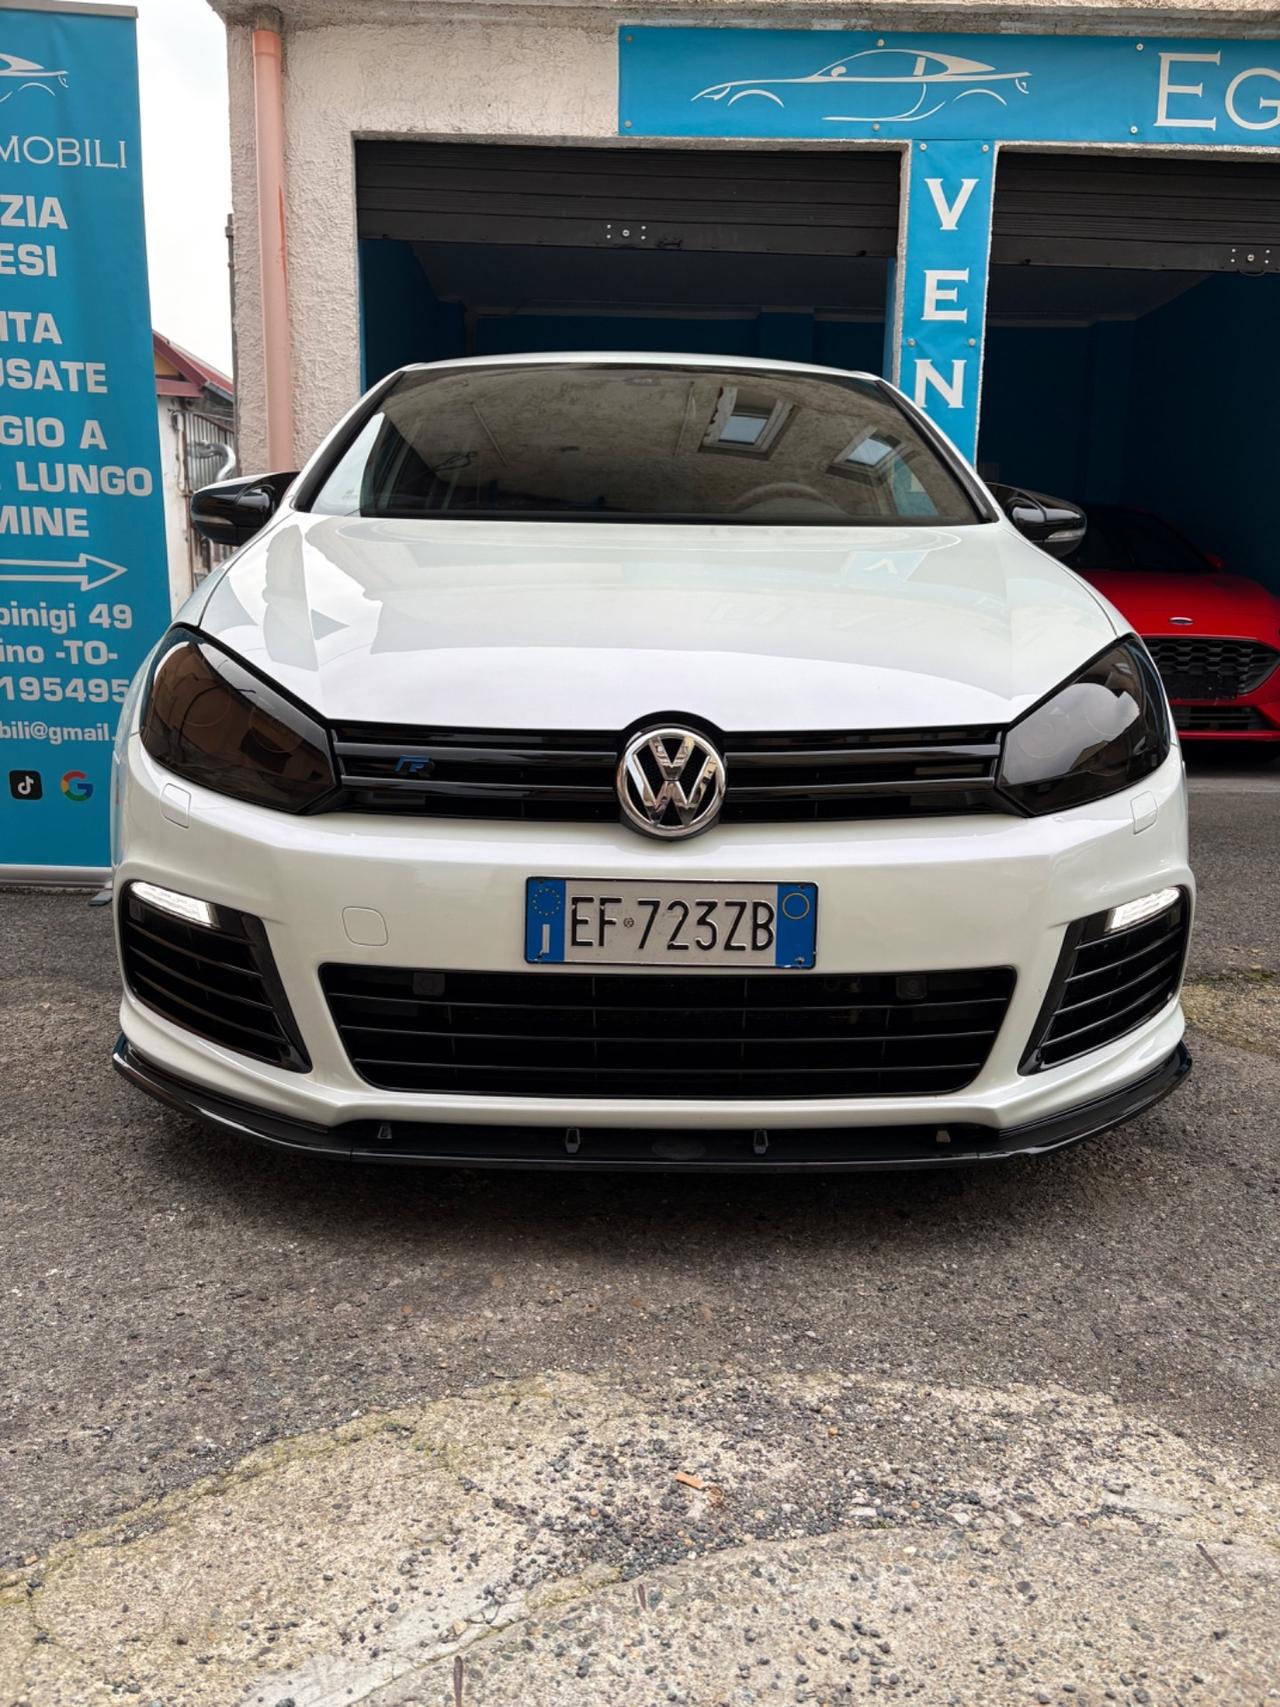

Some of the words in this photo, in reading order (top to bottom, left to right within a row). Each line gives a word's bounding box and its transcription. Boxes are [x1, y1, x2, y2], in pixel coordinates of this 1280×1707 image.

[1153, 50, 1280, 131] EG
[0, 135, 127, 169] MOBILI
[0, 194, 68, 229] ZIA
[0, 242, 57, 277] ESI
[914, 178, 979, 409] VEN
[0, 357, 108, 393] SATE
[0, 415, 65, 448] GIO
[79, 419, 108, 450] A
[16, 461, 153, 497] LUNGO
[88, 603, 133, 629] 49
[56, 640, 118, 665] -TO-
